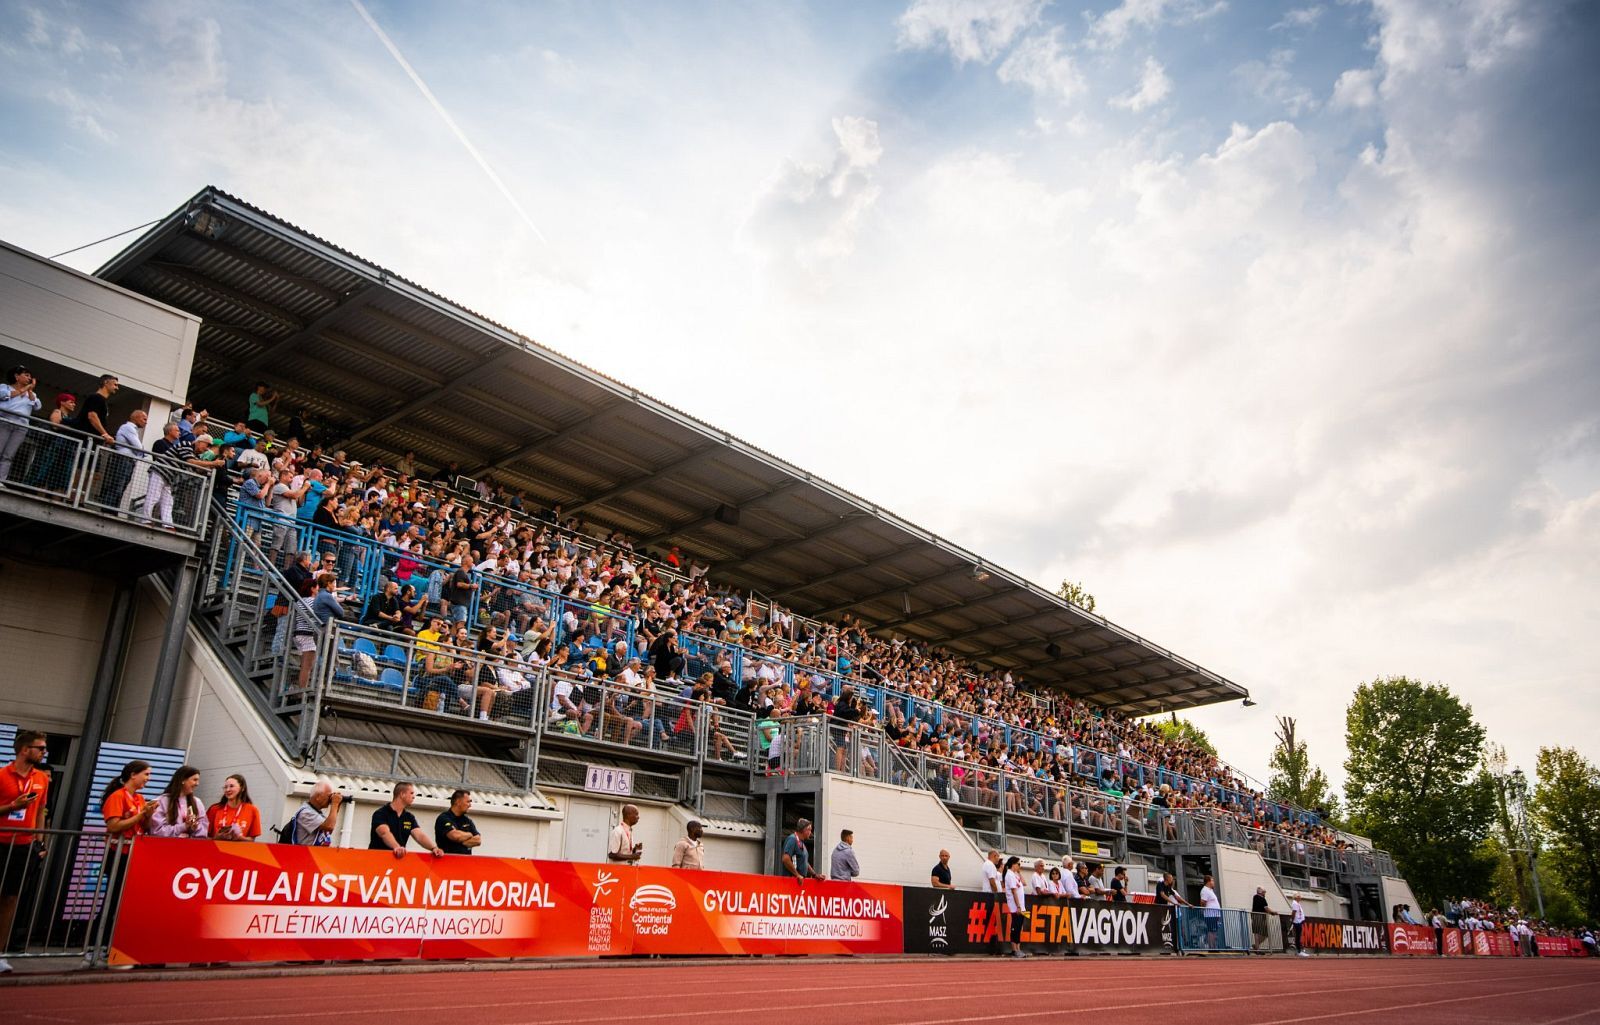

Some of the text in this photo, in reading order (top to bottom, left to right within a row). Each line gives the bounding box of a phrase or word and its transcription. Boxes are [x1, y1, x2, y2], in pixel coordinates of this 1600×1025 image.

[172, 867, 556, 908] GYULAI ISTVÁN MEMORIAL
[703, 889, 889, 919] GYULAI ISTVÁN MEMORIAL
[246, 910, 503, 936] ATLÉTIKAI MAGYAR NAGYDÍJ
[632, 912, 673, 924] Continental
[739, 918, 863, 937] ATLÉTIKAI MAGYAR NAGYDÍJ
[635, 924, 669, 935] Tour Gold
[929, 925, 947, 936] MASZ
